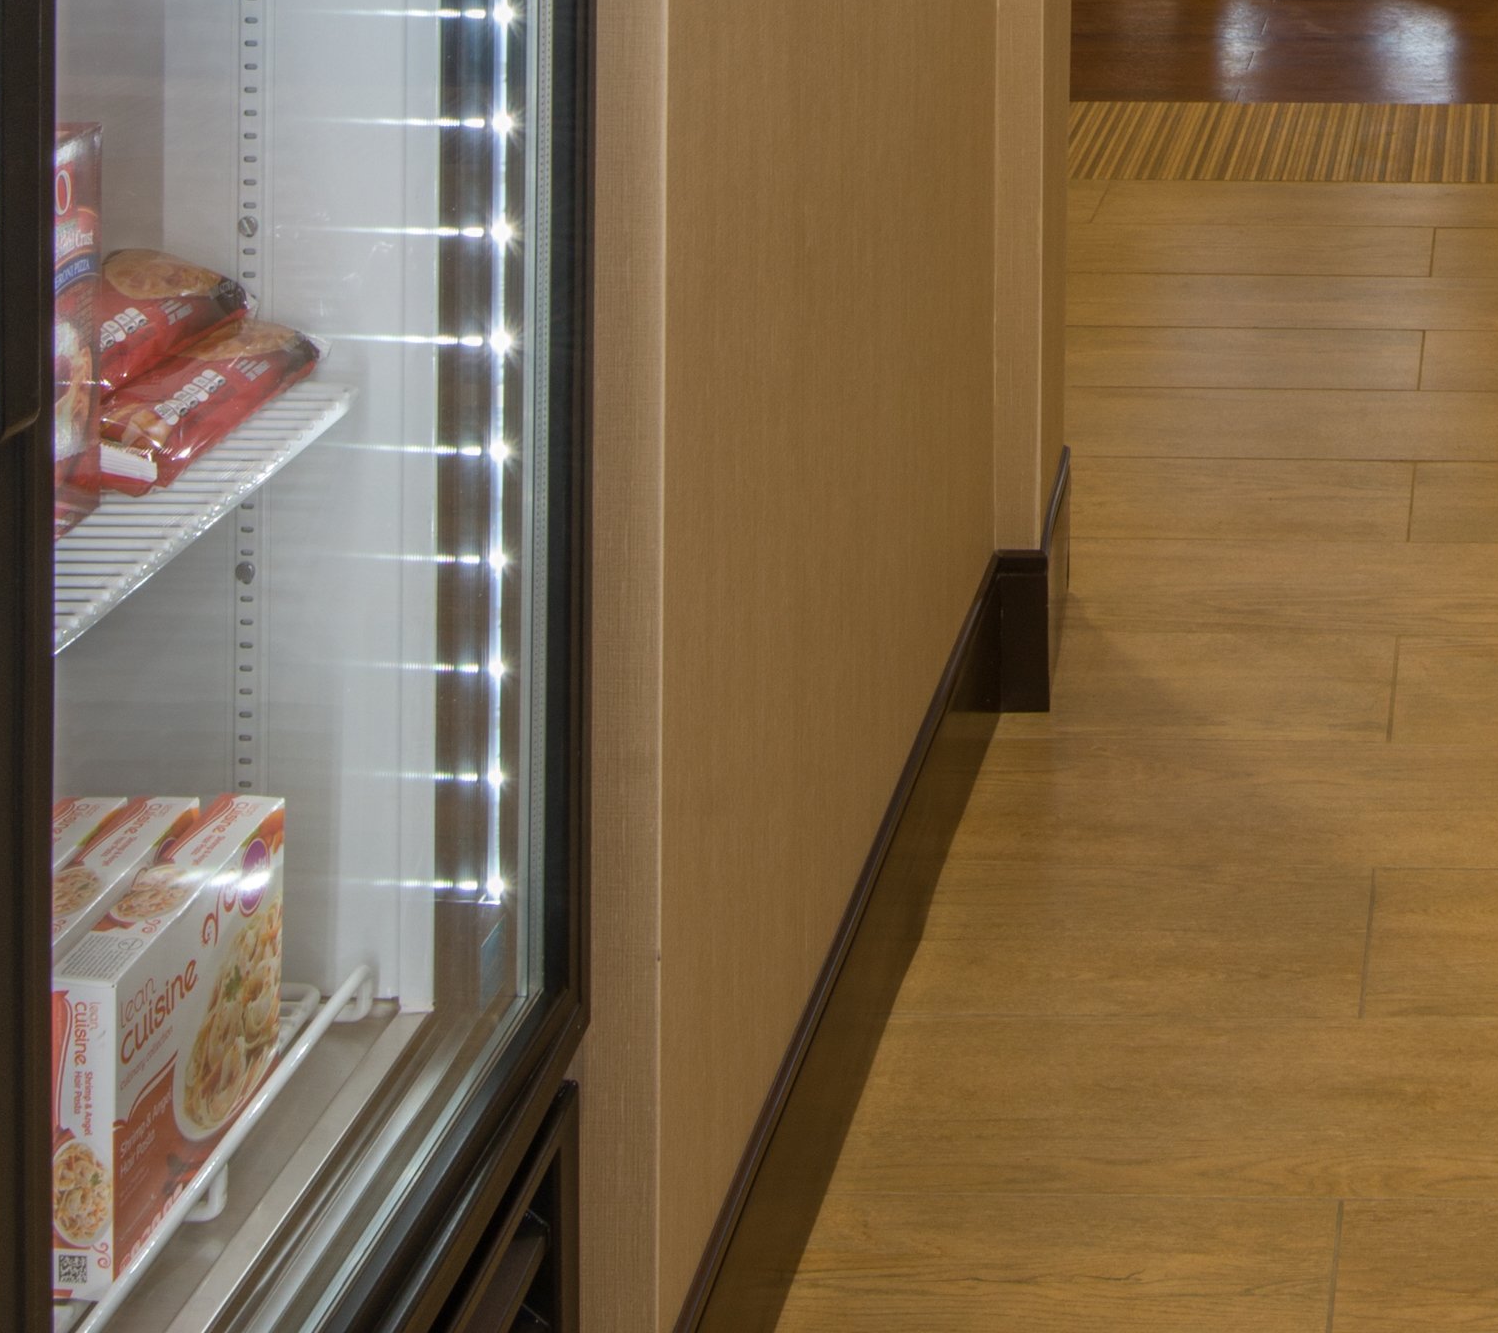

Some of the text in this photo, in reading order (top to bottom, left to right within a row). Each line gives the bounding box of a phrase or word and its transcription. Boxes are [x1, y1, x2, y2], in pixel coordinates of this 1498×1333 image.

[119, 976, 156, 1029] lean
[119, 958, 199, 1065] cuisine
[73, 1000, 91, 1067] cuisine
[73, 1070, 83, 1090] Hair
